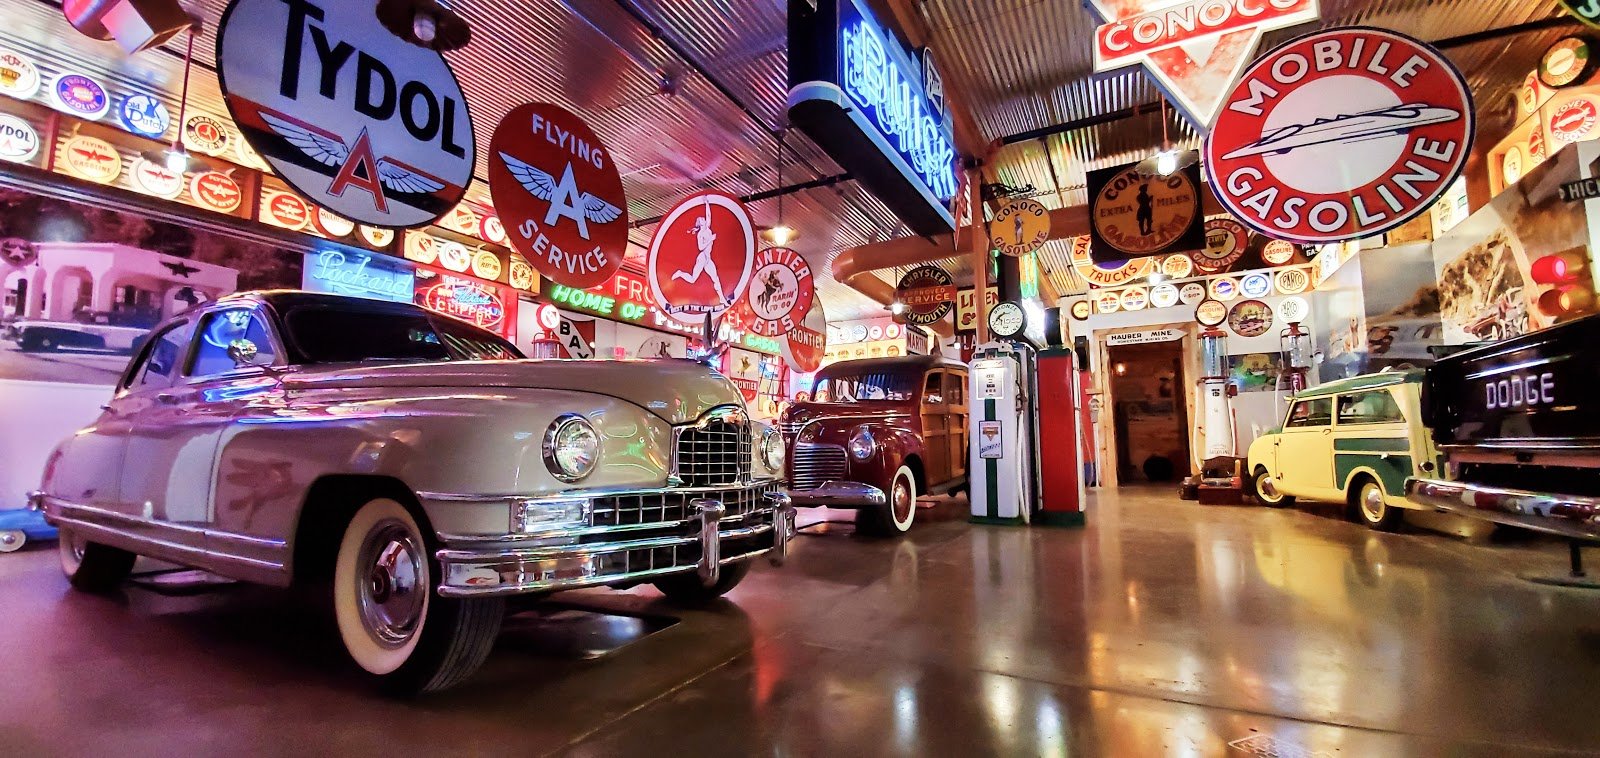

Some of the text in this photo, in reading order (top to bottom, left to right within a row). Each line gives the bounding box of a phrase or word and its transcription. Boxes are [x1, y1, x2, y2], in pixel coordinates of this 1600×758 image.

[280, 0, 465, 160] TYDOL
[1229, 38, 1429, 116] MOBILE
[63, 91, 100, 111] GASOLINE
[1557, 100, 1587, 117] COVEY
[129, 108, 165, 132] Dutch
[187, 116, 226, 137] MARATHON
[1553, 116, 1596, 142] GASOLINE
[82, 141, 108, 151] FLYING
[532, 113, 603, 169] FLYING
[73, 159, 111, 173] GASOLINE
[1105, 170, 1182, 200] CONO
[1227, 137, 1456, 233] GASOLINE
[1156, 194, 1190, 207] MILES
[997, 202, 1044, 222] CONOCO
[1100, 205, 1133, 217] EXTRA
[518, 219, 607, 274] SERVICE
[994, 230, 1047, 255] GASOLINE
[1265, 246, 1293, 256] GASOLINE
[312, 251, 414, 295] Packard
[903, 269, 946, 288] CHRYSLER
[1089, 264, 1138, 282] TRUCKS
[1283, 271, 1303, 290] PARCO
[552, 285, 647, 319] HOME OF
[898, 292, 951, 304] SERVICE
[903, 288, 945, 297] APPROVED
[437, 300, 492, 319] CLIPPER
[906, 305, 948, 323] PLYMOUTH
[994, 304, 1017, 314] BRONZE
[752, 314, 796, 336] GAS
[1111, 333, 1142, 341] HAUBER
[1485, 373, 1555, 410] DODGE
